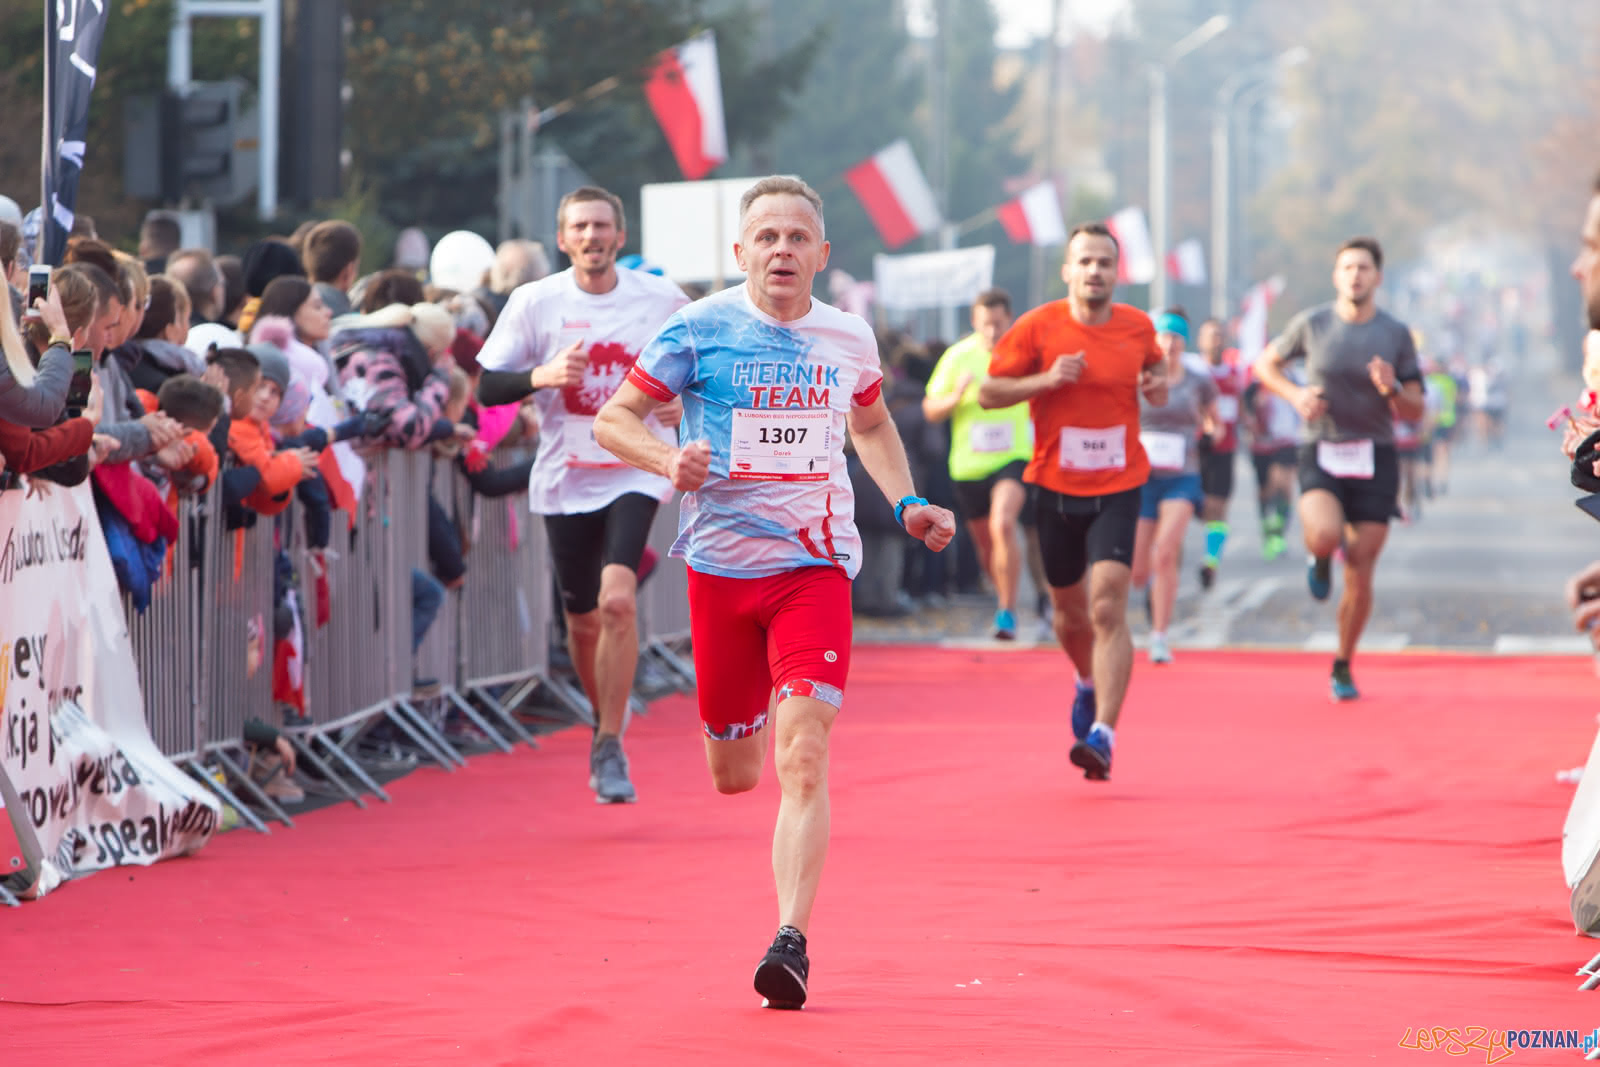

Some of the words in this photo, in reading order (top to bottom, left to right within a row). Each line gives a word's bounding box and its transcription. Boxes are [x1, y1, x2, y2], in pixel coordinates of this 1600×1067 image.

[732, 361, 840, 387] HERNIK
[749, 386, 830, 409] TEAM
[758, 427, 808, 445] 1307
